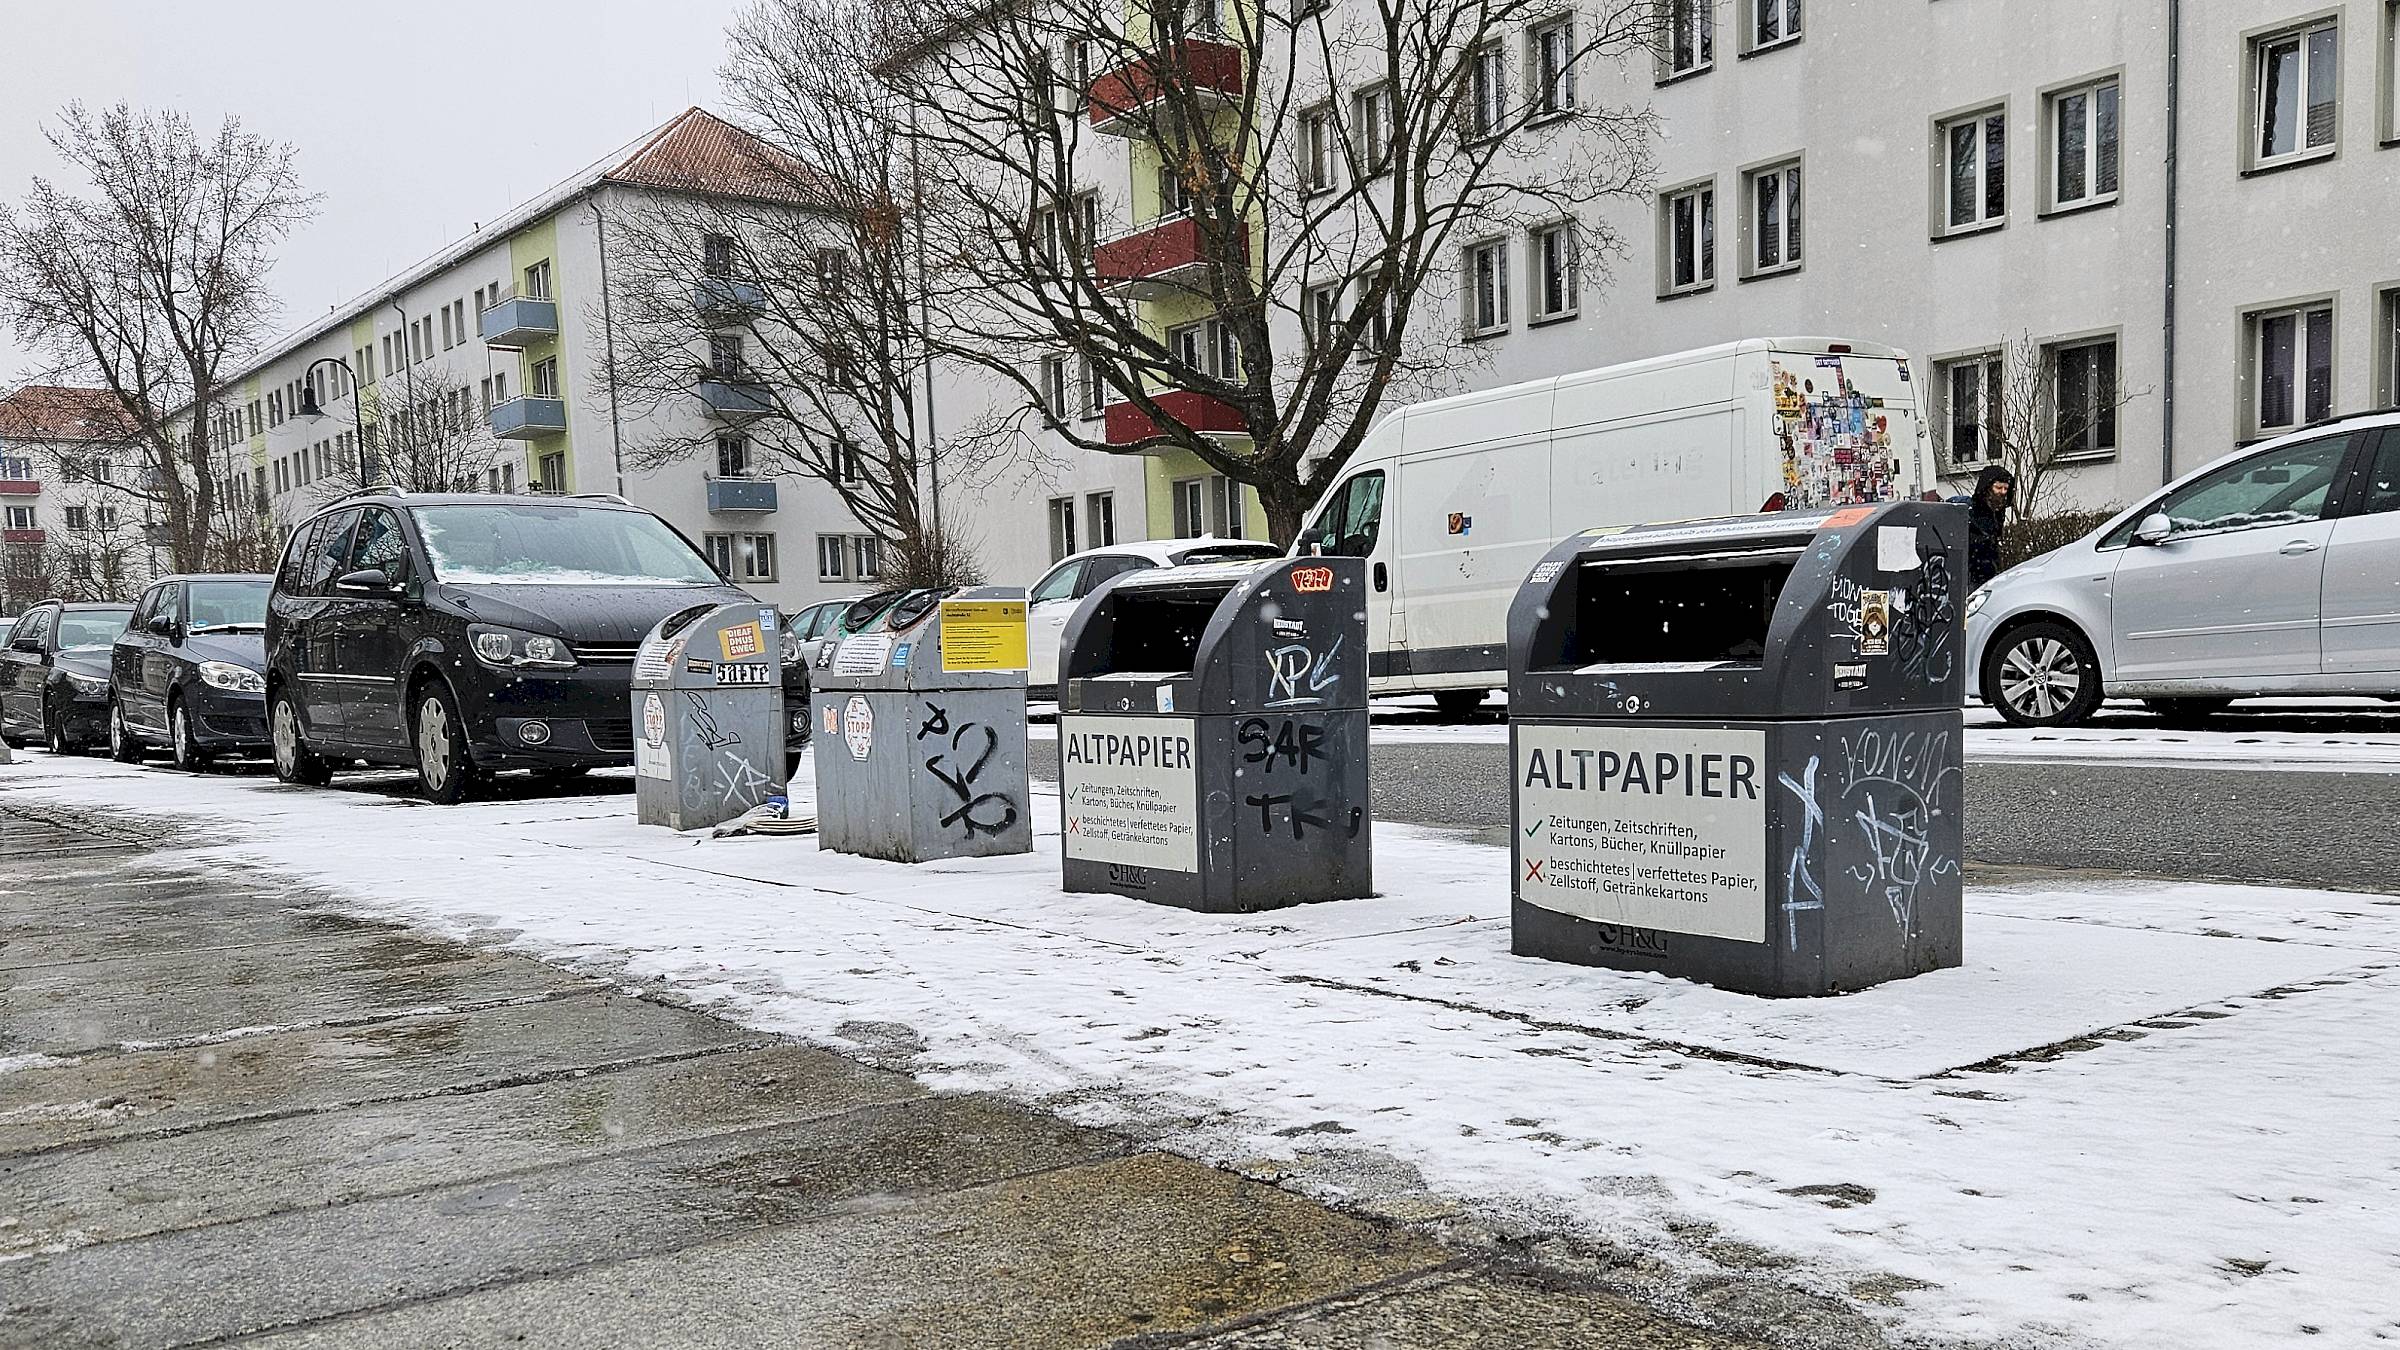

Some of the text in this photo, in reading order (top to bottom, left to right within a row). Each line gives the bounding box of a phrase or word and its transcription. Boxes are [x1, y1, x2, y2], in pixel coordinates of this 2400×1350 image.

[728, 627, 752, 637] DIEAF
[729, 636, 753, 646] DMUS
[730, 644, 755, 654] SWEG
[847, 721, 870, 733] STOPP
[1067, 733, 1191, 769] ALTPAPIER
[1525, 748, 1757, 800] ALTPAPIER
[1081, 783, 1162, 800] Zeitungen, Zeitschriften,
[1082, 796, 1177, 815] Kartons, Bücher, Knüllpapier
[1169, 821, 1194, 836] Papier,
[1549, 815, 1698, 840] Zeitungen, Zeitschriften,
[1082, 828, 1169, 846] Zellstoff, Getränkekartons
[1550, 833, 1726, 861] Kartons, Bücher, Knüllpapier
[1550, 874, 1708, 903] Zellstoff, Getränkekartons
[1711, 874, 1758, 892] Papier,
[1620, 925, 1668, 951] H&G
